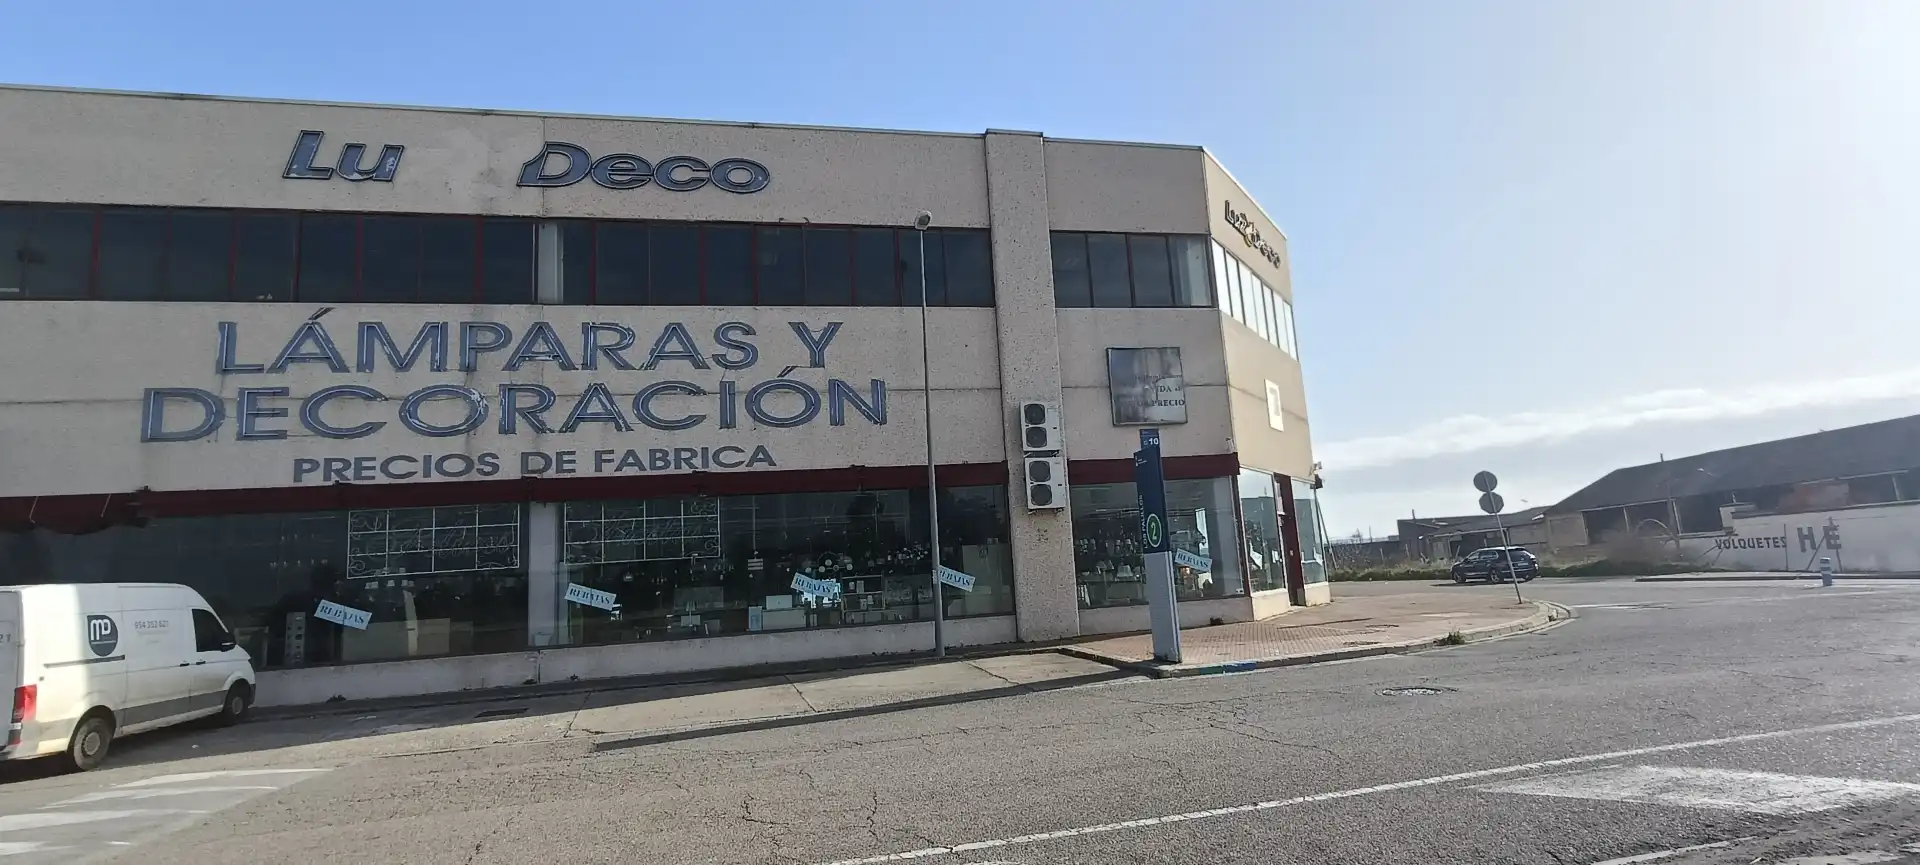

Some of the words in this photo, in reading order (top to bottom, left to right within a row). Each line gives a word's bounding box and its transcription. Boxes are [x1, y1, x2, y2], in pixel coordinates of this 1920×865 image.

[282, 129, 404, 182] Lu
[516, 141, 771, 194] Deco
[215, 307, 759, 374] LÁMPARAS
[787, 321, 844, 369] Y
[140, 365, 888, 442] DECORACIÓN
[1149, 437, 1159, 445] 10
[293, 452, 500, 483] PRECIOS
[520, 450, 577, 475] DE
[594, 444, 778, 473] FABRICA
[1150, 521, 1158, 540] 2
[1715, 536, 1787, 550] VOLQUETES
[1177, 552, 1209, 568] REBAJAS
[795, 577, 832, 593] REBAJAS
[569, 588, 611, 605] REBAJAS
[319, 605, 365, 624] REBAJAS
